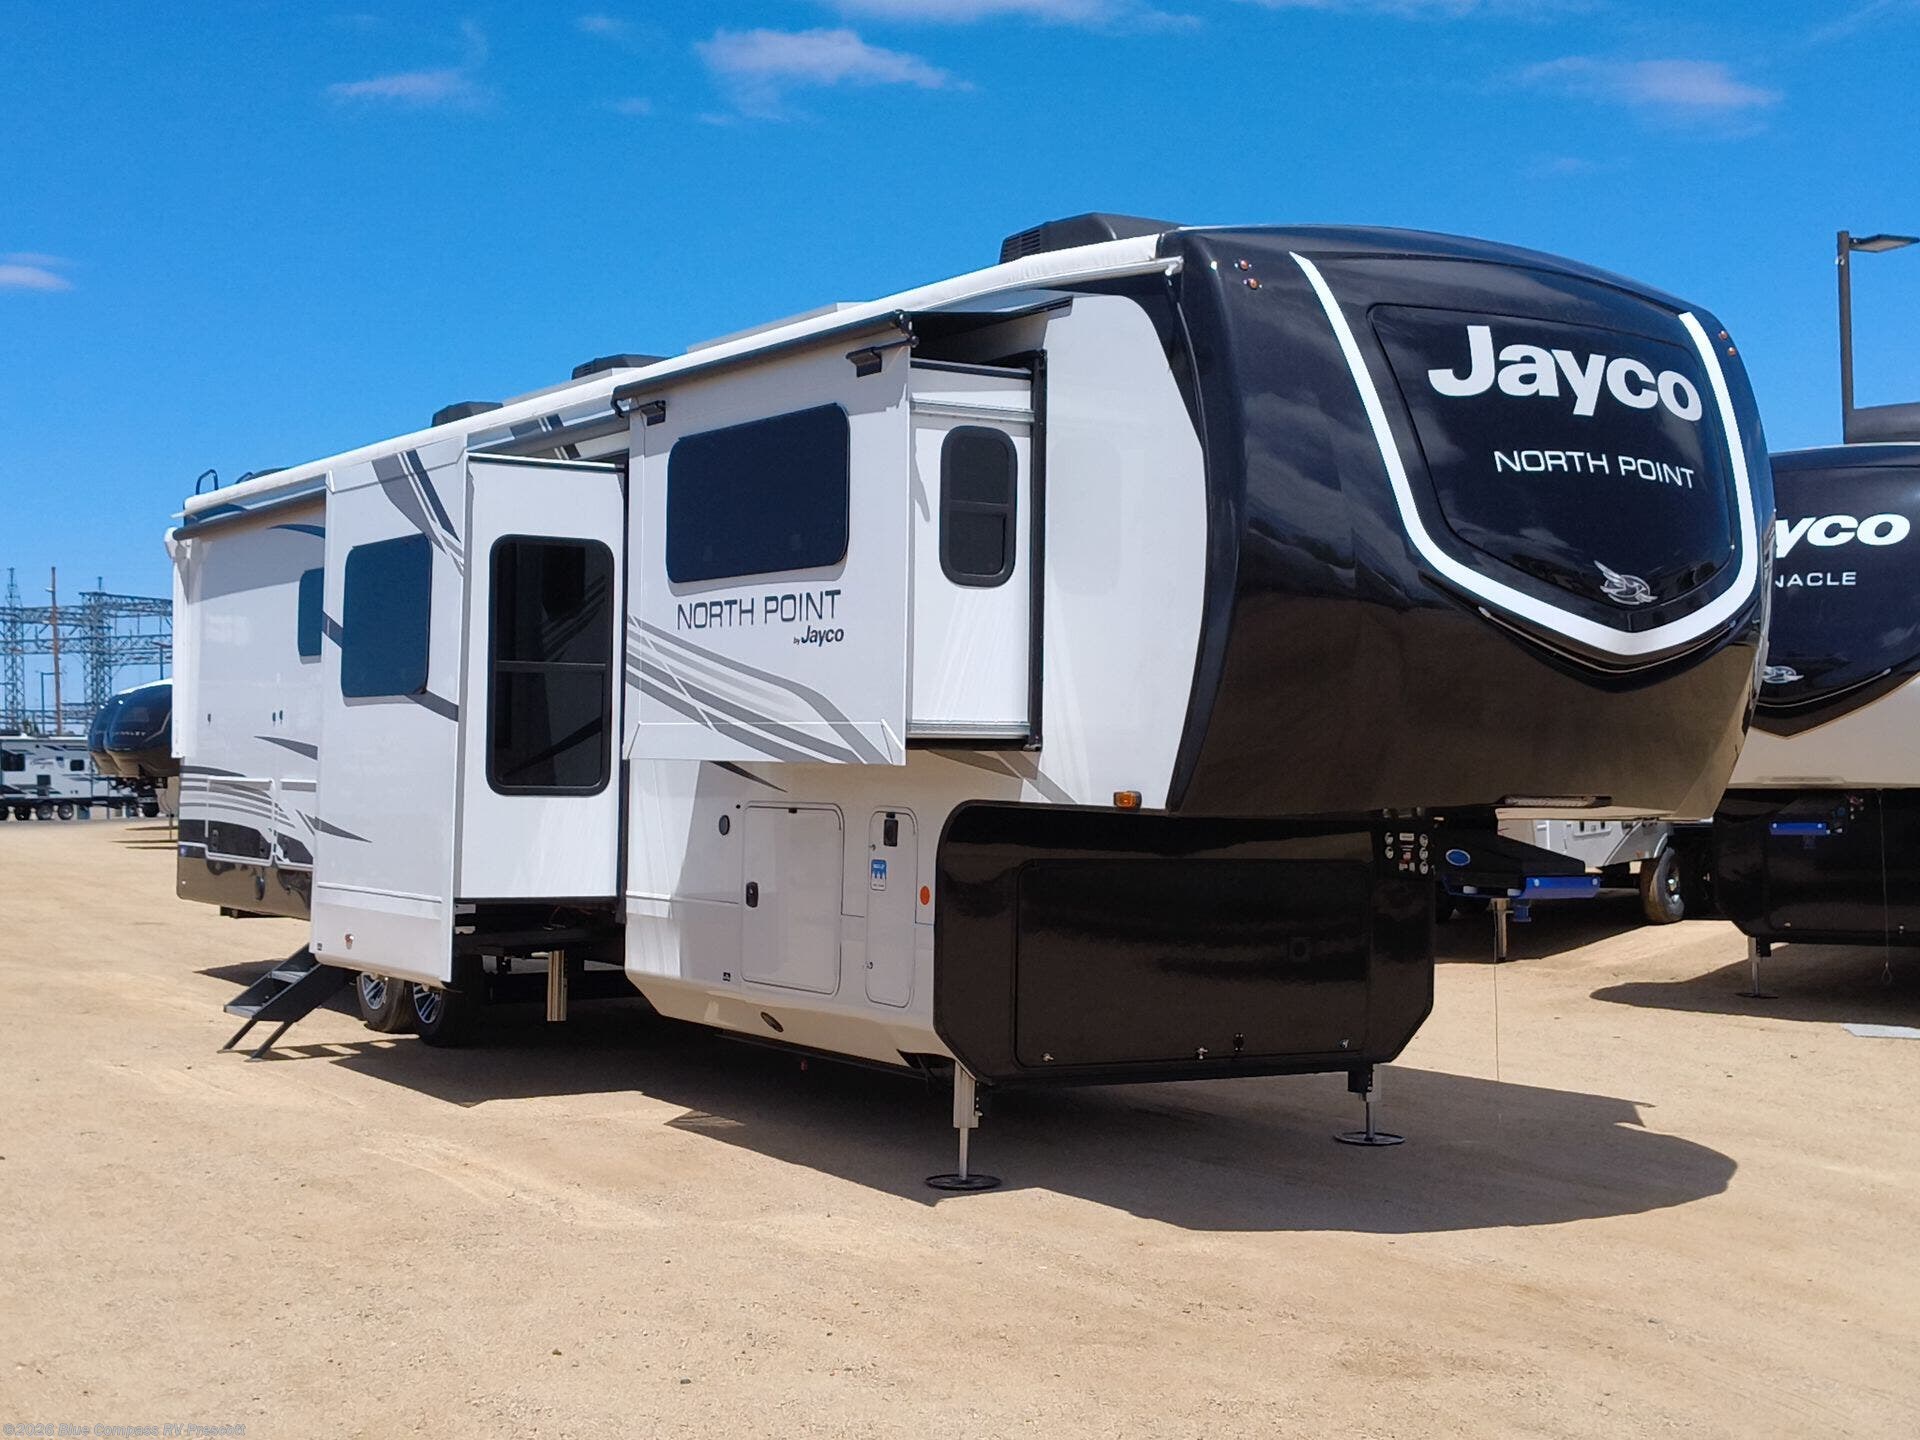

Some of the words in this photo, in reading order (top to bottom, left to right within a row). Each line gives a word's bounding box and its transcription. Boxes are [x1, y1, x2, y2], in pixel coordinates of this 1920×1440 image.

[1428, 325, 1703, 421] Jayco
[1494, 450, 1609, 475] NORTH
[1619, 456, 1695, 489] POINT
[677, 598, 755, 630] NORTH
[764, 589, 842, 624] POINT
[793, 636, 801, 645] by
[801, 625, 845, 647] Jayco
